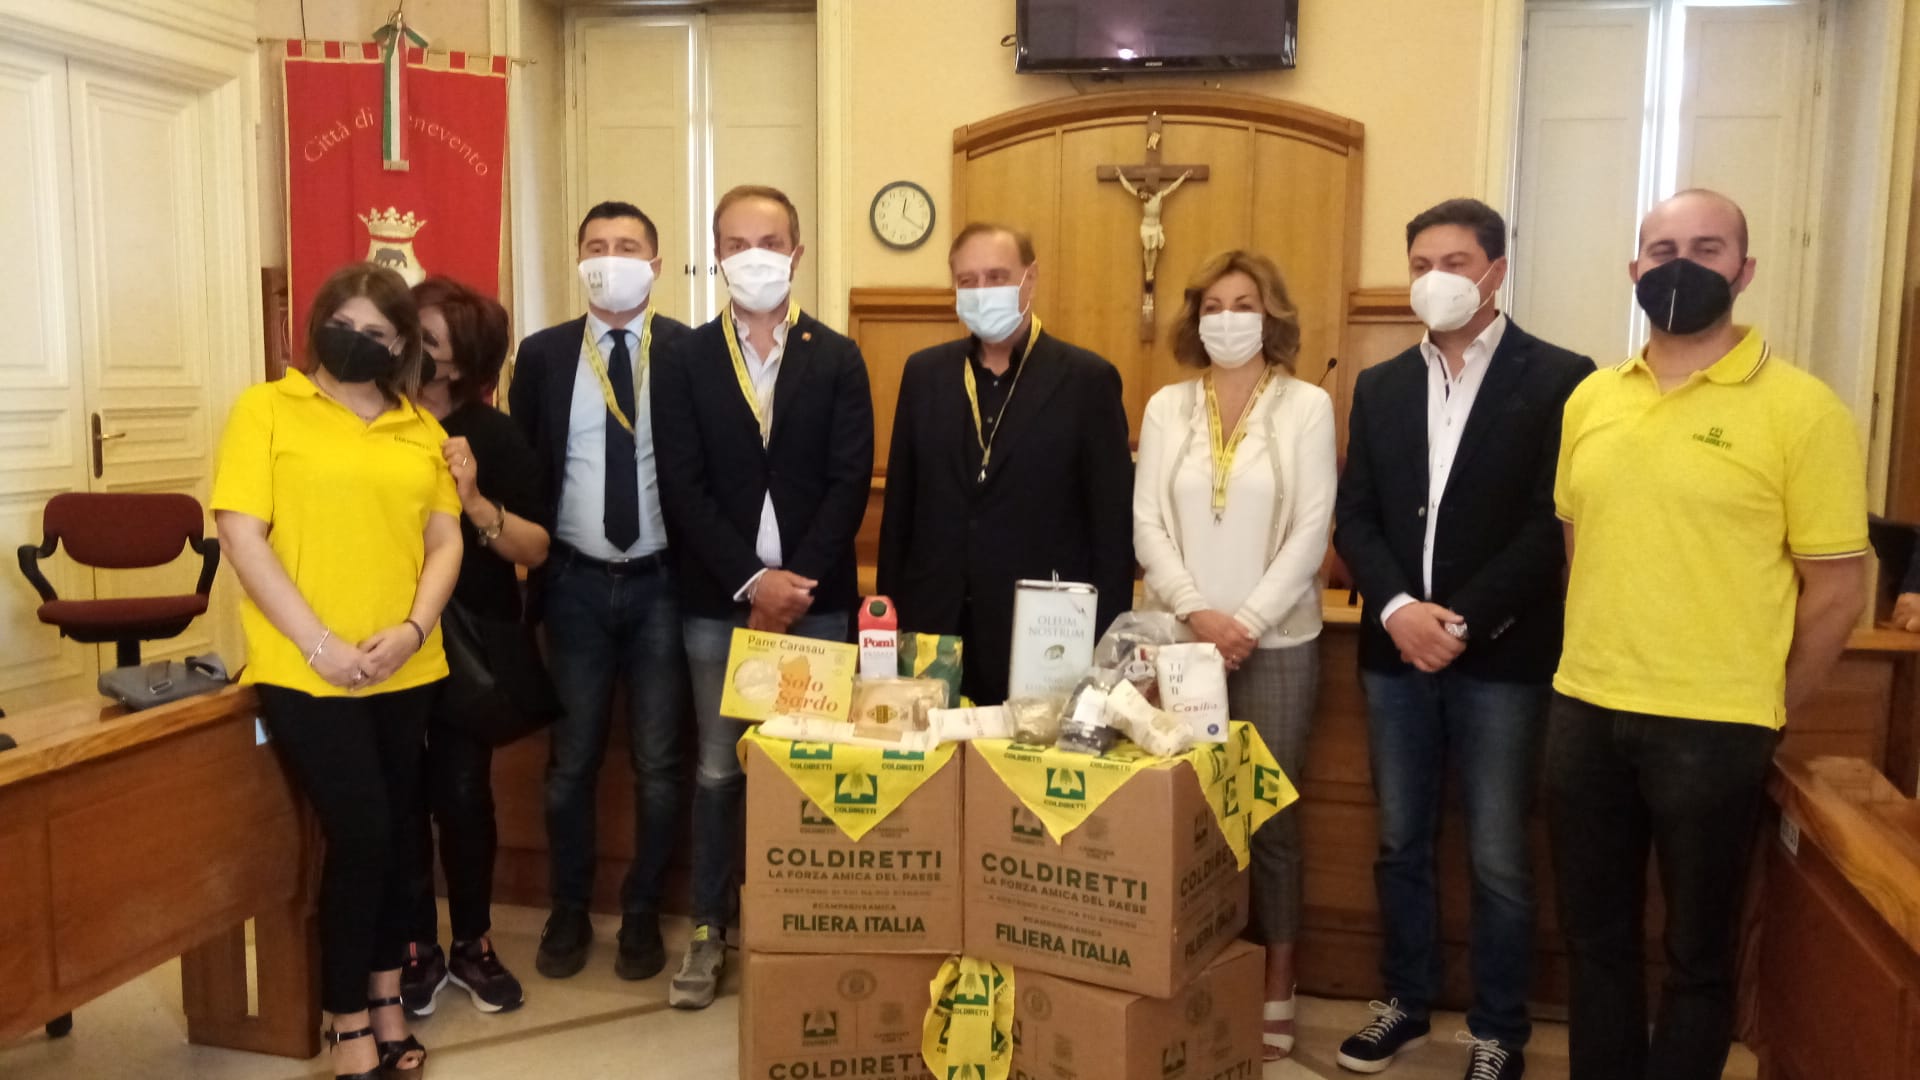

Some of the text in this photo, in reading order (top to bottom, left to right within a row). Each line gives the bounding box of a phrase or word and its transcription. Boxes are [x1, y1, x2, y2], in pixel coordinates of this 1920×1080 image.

[304, 107, 488, 176] Città di nevento
[1037, 615, 1078, 627] OLEUM
[1028, 626, 1085, 639] NOSTRUM
[748, 635, 777, 649] Pane
[779, 639, 826, 655] Carasau
[779, 672, 824, 692] Solo
[776, 690, 838, 713] Sardo
[790, 762, 833, 771] COLDIRETTI
[881, 763, 925, 772] COLDIRETTI
[1003, 752, 1042, 764] COLDIRETTI
[834, 807, 877, 815] COLDIRETTI
[1043, 799, 1087, 811] COLDIRETTI
[767, 847, 942, 869] COLDIRETTI
[768, 869, 941, 882] LA FORZA AMICA DEL PAESE
[981, 852, 1148, 901] COLDIRETTI
[983, 875, 1147, 915] LA FORZA AMICA DEL PAESE
[782, 914, 926, 933] FILIERA ITALIA
[995, 922, 1132, 968] FILIERA ITALIA
